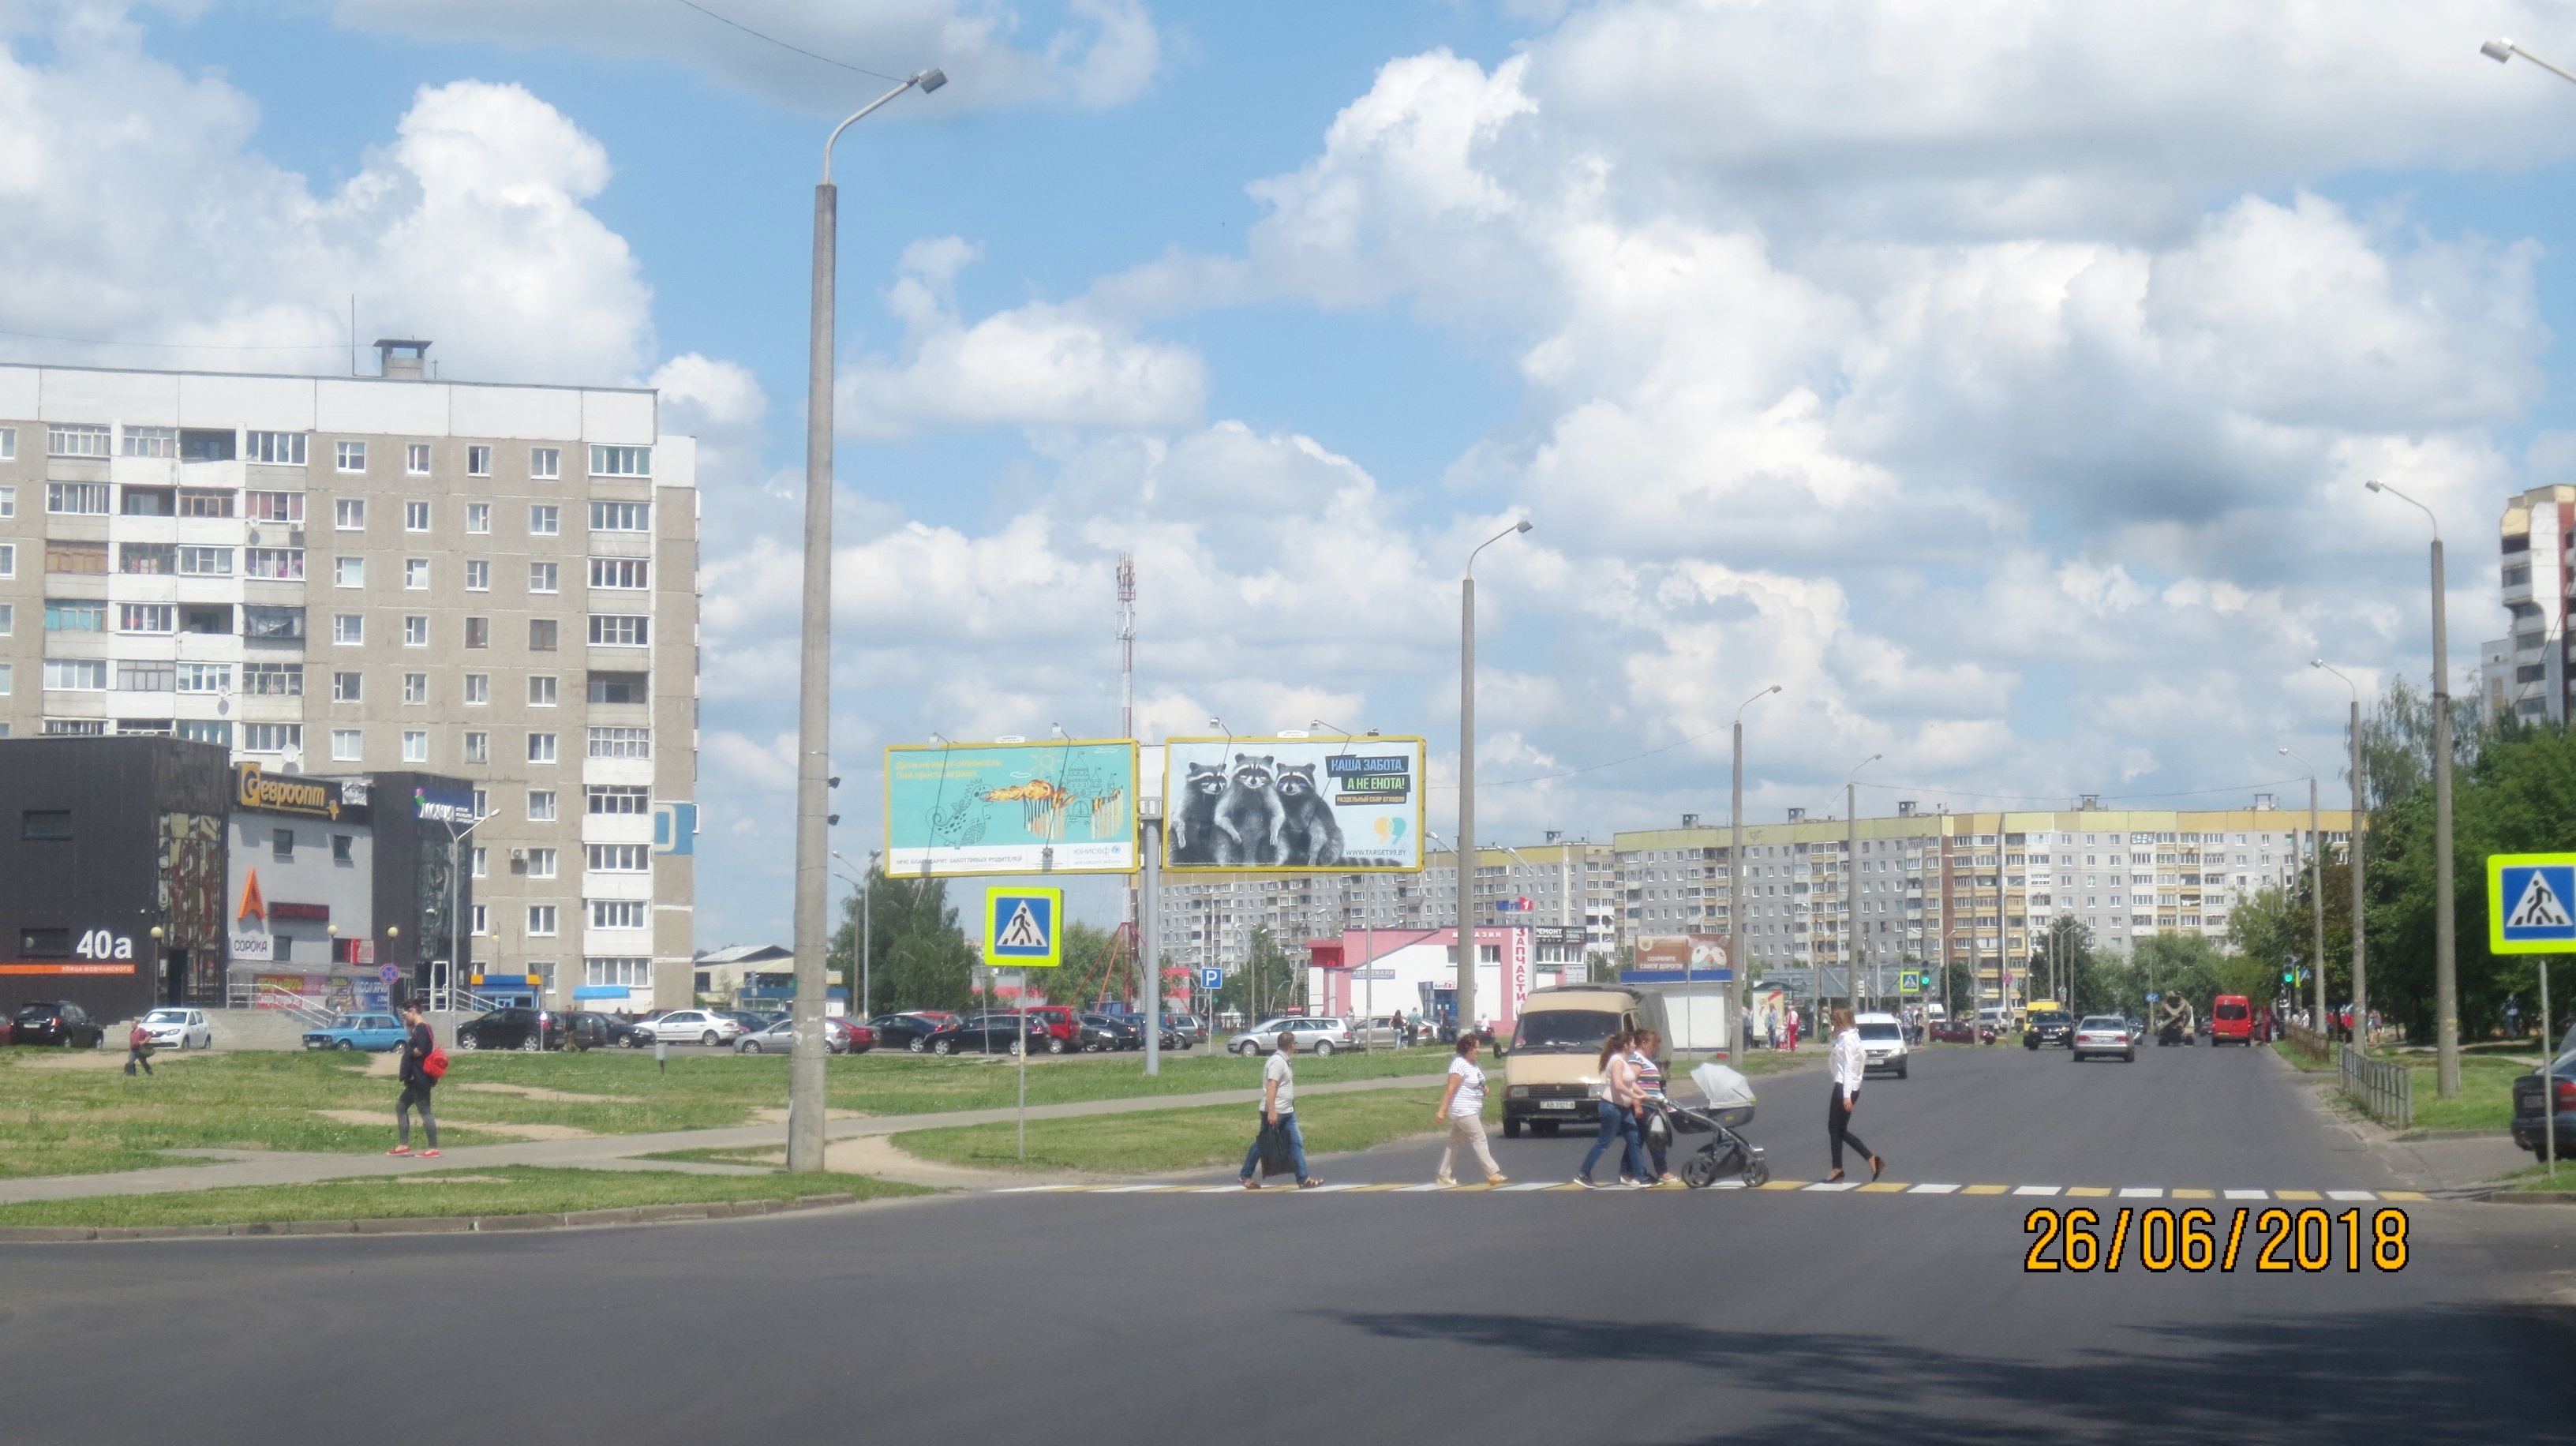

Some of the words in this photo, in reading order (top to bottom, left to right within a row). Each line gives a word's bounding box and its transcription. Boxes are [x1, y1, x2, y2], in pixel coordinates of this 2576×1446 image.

[1364, 758, 1405, 771] ЗАБОТА,
[1347, 777, 1354, 789] А
[1357, 777, 1369, 789] НЕ
[1371, 777, 1405, 789] ЕНОТА!
[77, 930, 133, 959] 40а
[234, 939, 268, 953] СОРОКА
[1515, 927, 1526, 1002] ЗАПЧАСТИ
